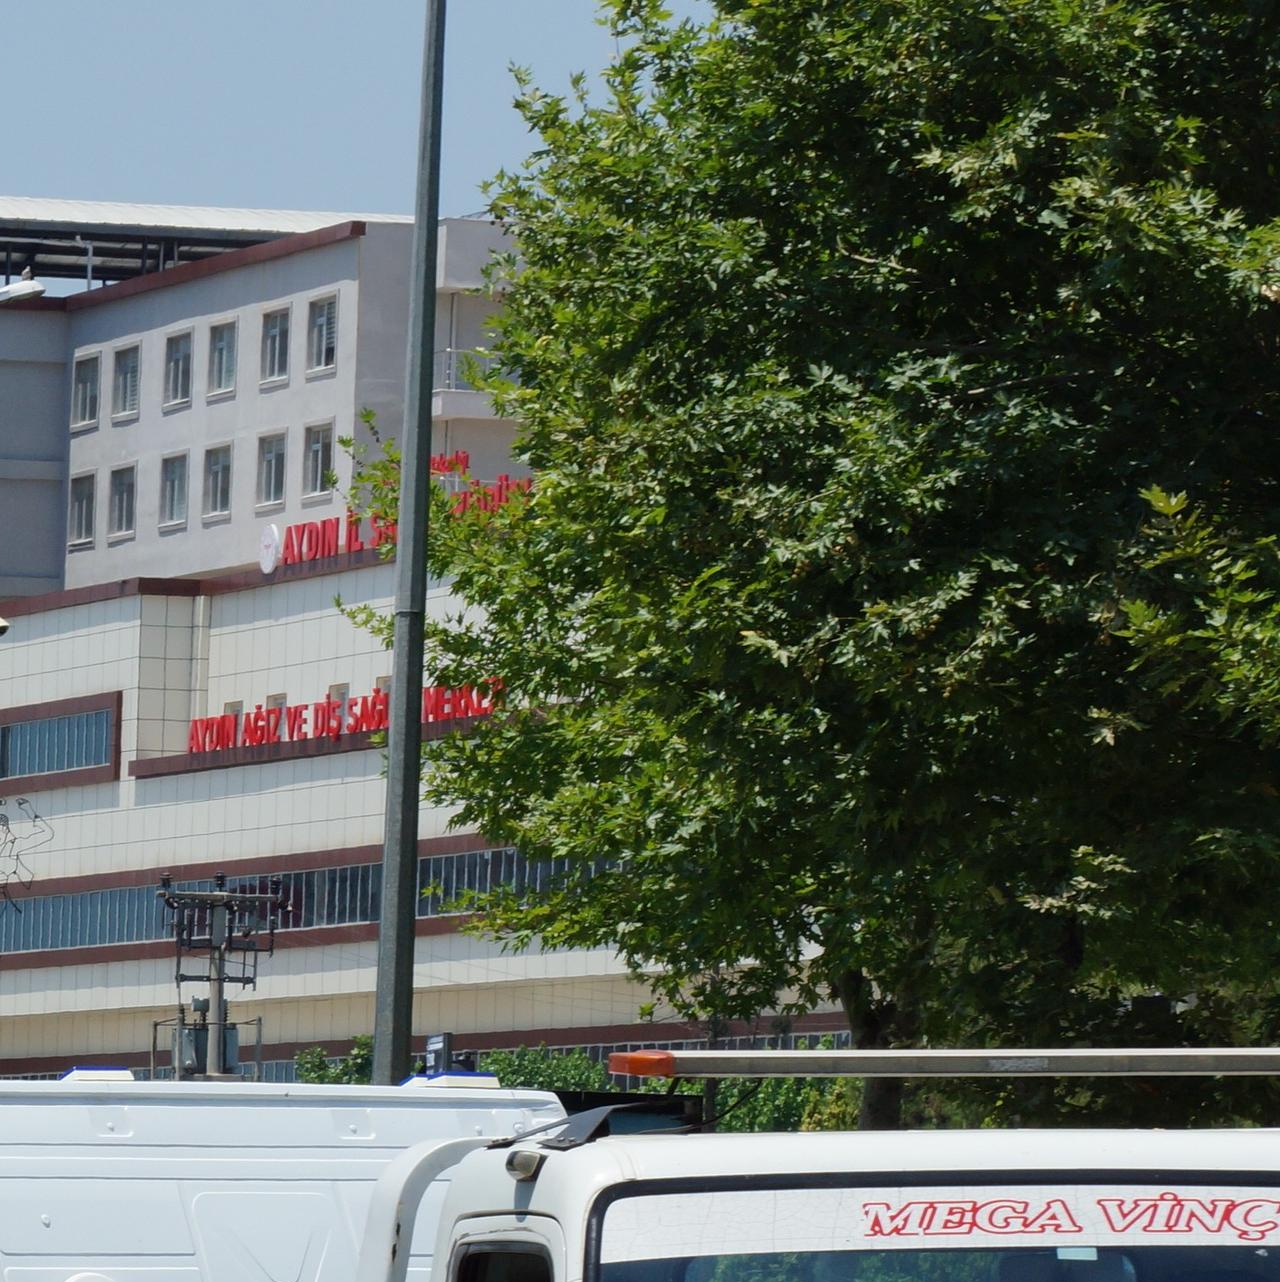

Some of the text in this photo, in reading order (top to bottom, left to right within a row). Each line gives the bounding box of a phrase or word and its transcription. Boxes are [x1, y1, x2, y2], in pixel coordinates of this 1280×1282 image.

[281, 517, 339, 565] AYDIN
[189, 713, 237, 752] AYDIN
[241, 704, 280, 746] AĞIZ
[286, 704, 308, 741] VE
[313, 694, 341, 741] DİŞ
[862, 1191, 1280, 1241] MEGA VİNÇ
